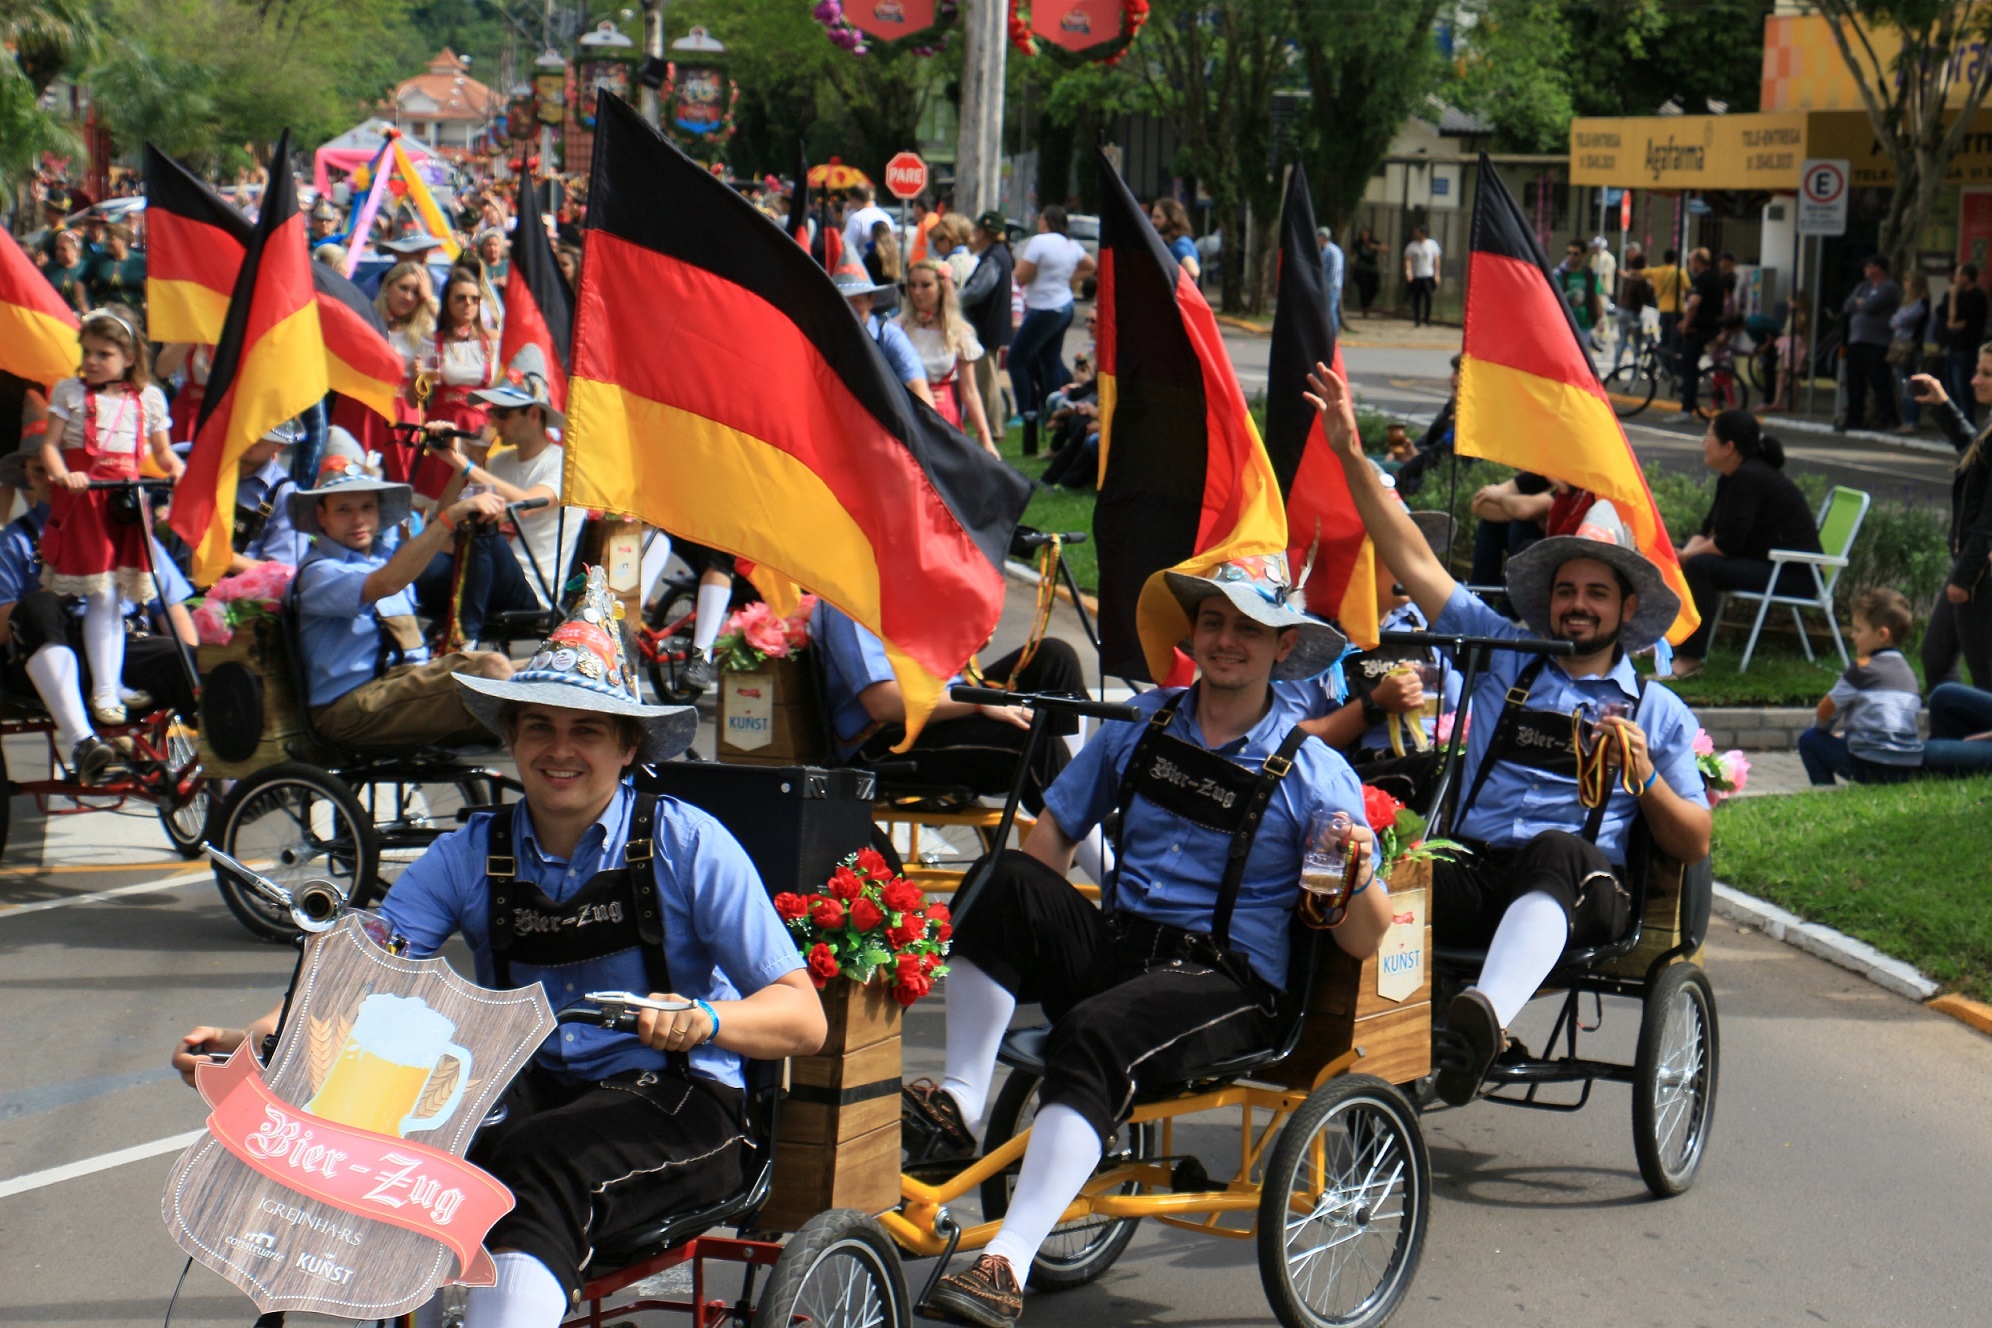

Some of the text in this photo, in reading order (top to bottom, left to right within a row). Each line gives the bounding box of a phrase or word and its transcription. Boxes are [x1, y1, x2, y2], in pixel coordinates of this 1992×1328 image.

[1644, 135, 1705, 180] Agafarma
[890, 167, 922, 184] PARE
[1815, 172, 1831, 196] E
[729, 716, 768, 731] KUNST
[1149, 755, 1236, 808] Bier-Zug
[513, 901, 623, 936] Bier-Zug
[1383, 950, 1421, 973] KUNST
[257, 1197, 364, 1246] IGREJINHA-RS
[225, 1235, 286, 1263] construarte
[295, 1252, 354, 1285] KUNST
